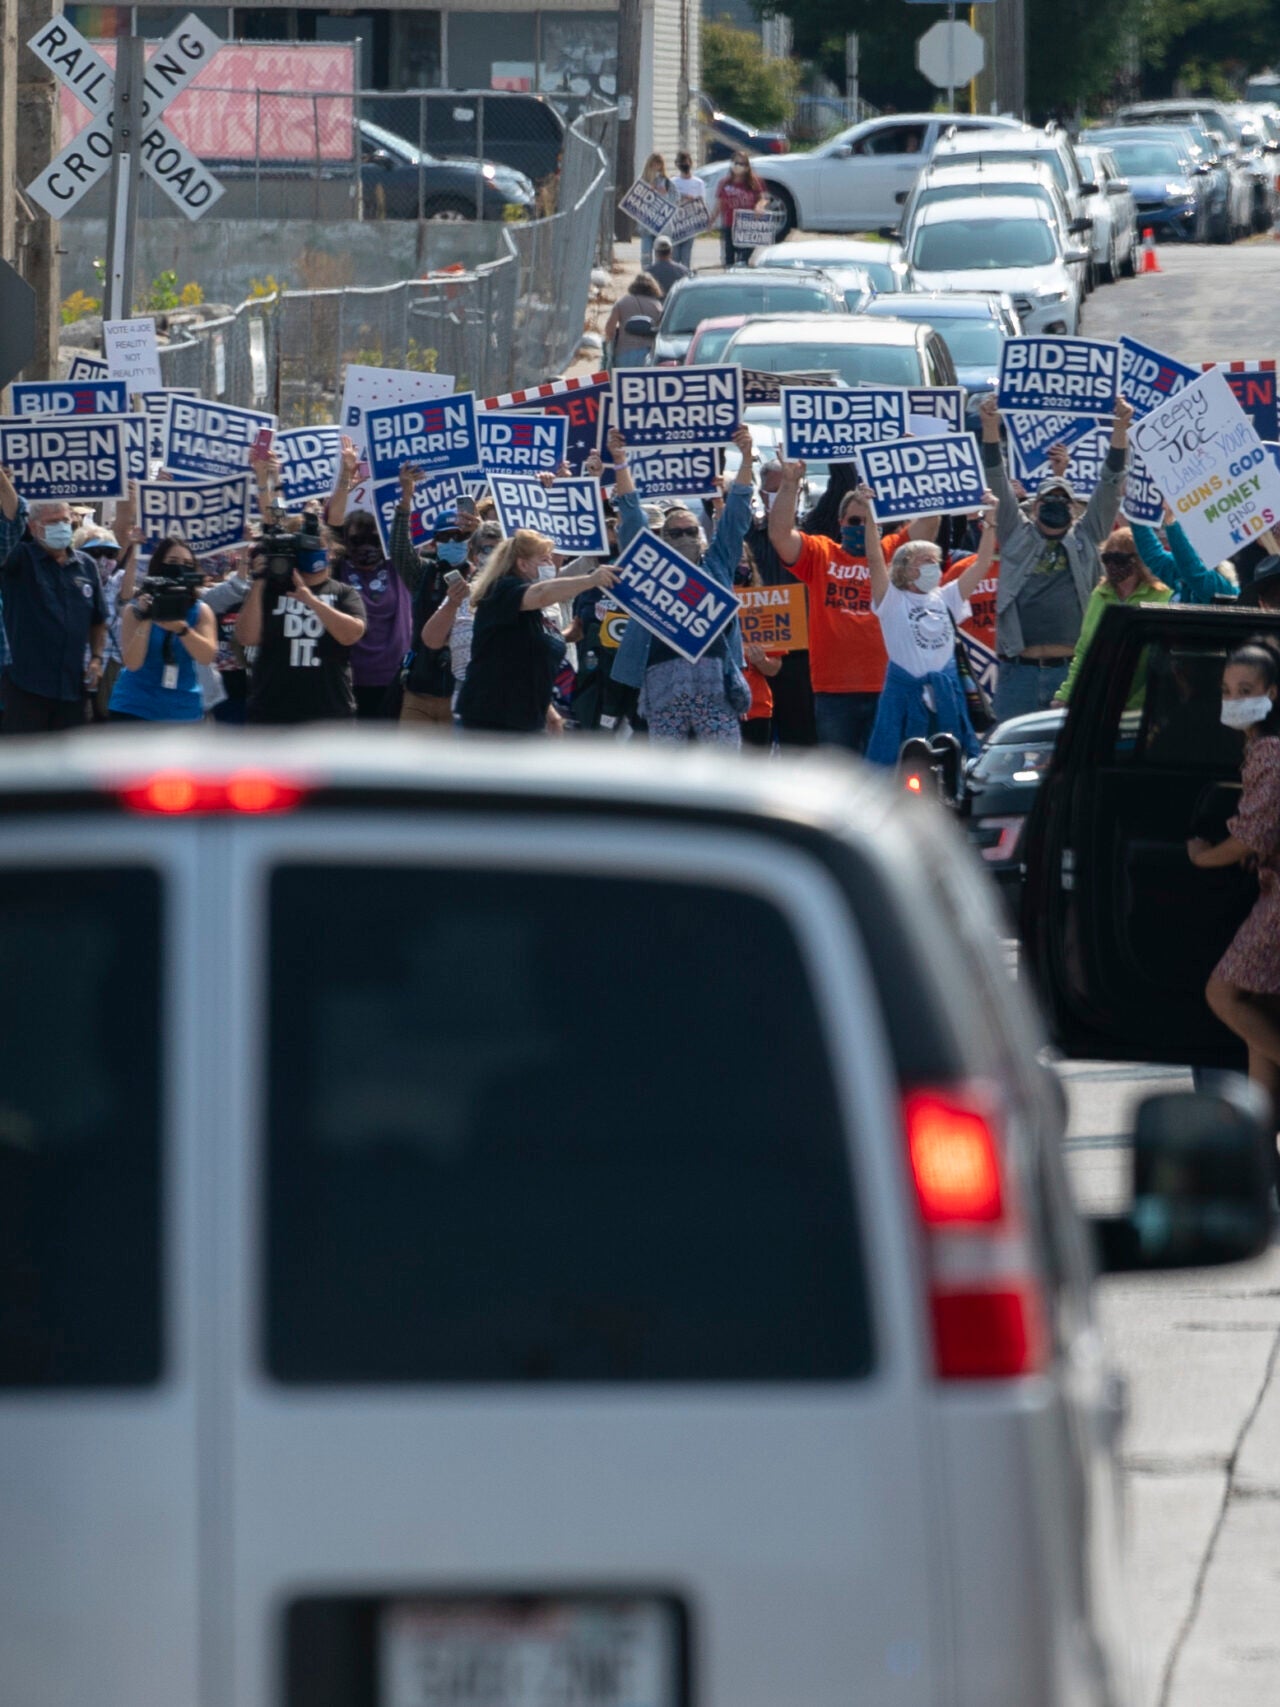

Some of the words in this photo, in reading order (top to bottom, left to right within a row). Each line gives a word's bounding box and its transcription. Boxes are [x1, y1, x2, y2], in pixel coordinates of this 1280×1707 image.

[37, 25, 106, 104] RAIL
[141, 129, 212, 207] ROAD
[47, 33, 205, 200] CROING
[633, 184, 673, 216] BIDEN
[107, 326, 128, 334] VOTE
[138, 324, 152, 332] JOE
[115, 340, 146, 348] REALITY
[112, 368, 144, 377] REALITY
[1005, 344, 1114, 375] BIDEN
[621, 373, 734, 404] BIDEN
[1003, 372, 1112, 398] HARRIS
[20, 390, 119, 415] BIDEN
[789, 394, 899, 420] BIDEN
[1042, 396, 1071, 407] 2020
[372, 404, 467, 441] BIDEN
[623, 403, 735, 429] HARRIS
[1136, 390, 1208, 452] Creepy
[5, 429, 116, 459] BIDEN
[481, 423, 557, 447] IDEN
[665, 430, 694, 440] 2020
[791, 420, 899, 443] HARRIS
[172, 432, 250, 467] HARRI
[272, 433, 337, 464] BIDE
[374, 429, 470, 462] HARRIS
[480, 446, 555, 467] ARRIS
[832, 445, 856, 455] 202
[9, 458, 116, 483] HARRIS
[632, 456, 711, 481] ARRIS
[866, 442, 974, 477] BIDEN
[1229, 448, 1265, 477] GOD
[50, 484, 78, 494] 2020
[143, 482, 243, 516] BIDEN
[497, 482, 595, 512] BIDEN
[645, 482, 673, 493] 2020
[874, 470, 979, 501] HARRIS
[1203, 475, 1261, 523] MONEY
[917, 496, 945, 508] 2020
[1228, 501, 1256, 528] AND
[145, 508, 242, 539] HARRIS
[504, 508, 597, 536] HARRIS
[1229, 508, 1274, 544] KIDS
[632, 543, 727, 621] BIDEN
[826, 582, 871, 600] BIDE
[620, 563, 711, 638] HARRIS
[825, 597, 870, 611] HARR
[284, 614, 325, 638] DO
[739, 613, 790, 630] IDEN
[742, 629, 791, 643] ARRIS
[290, 639, 321, 667] IT.
